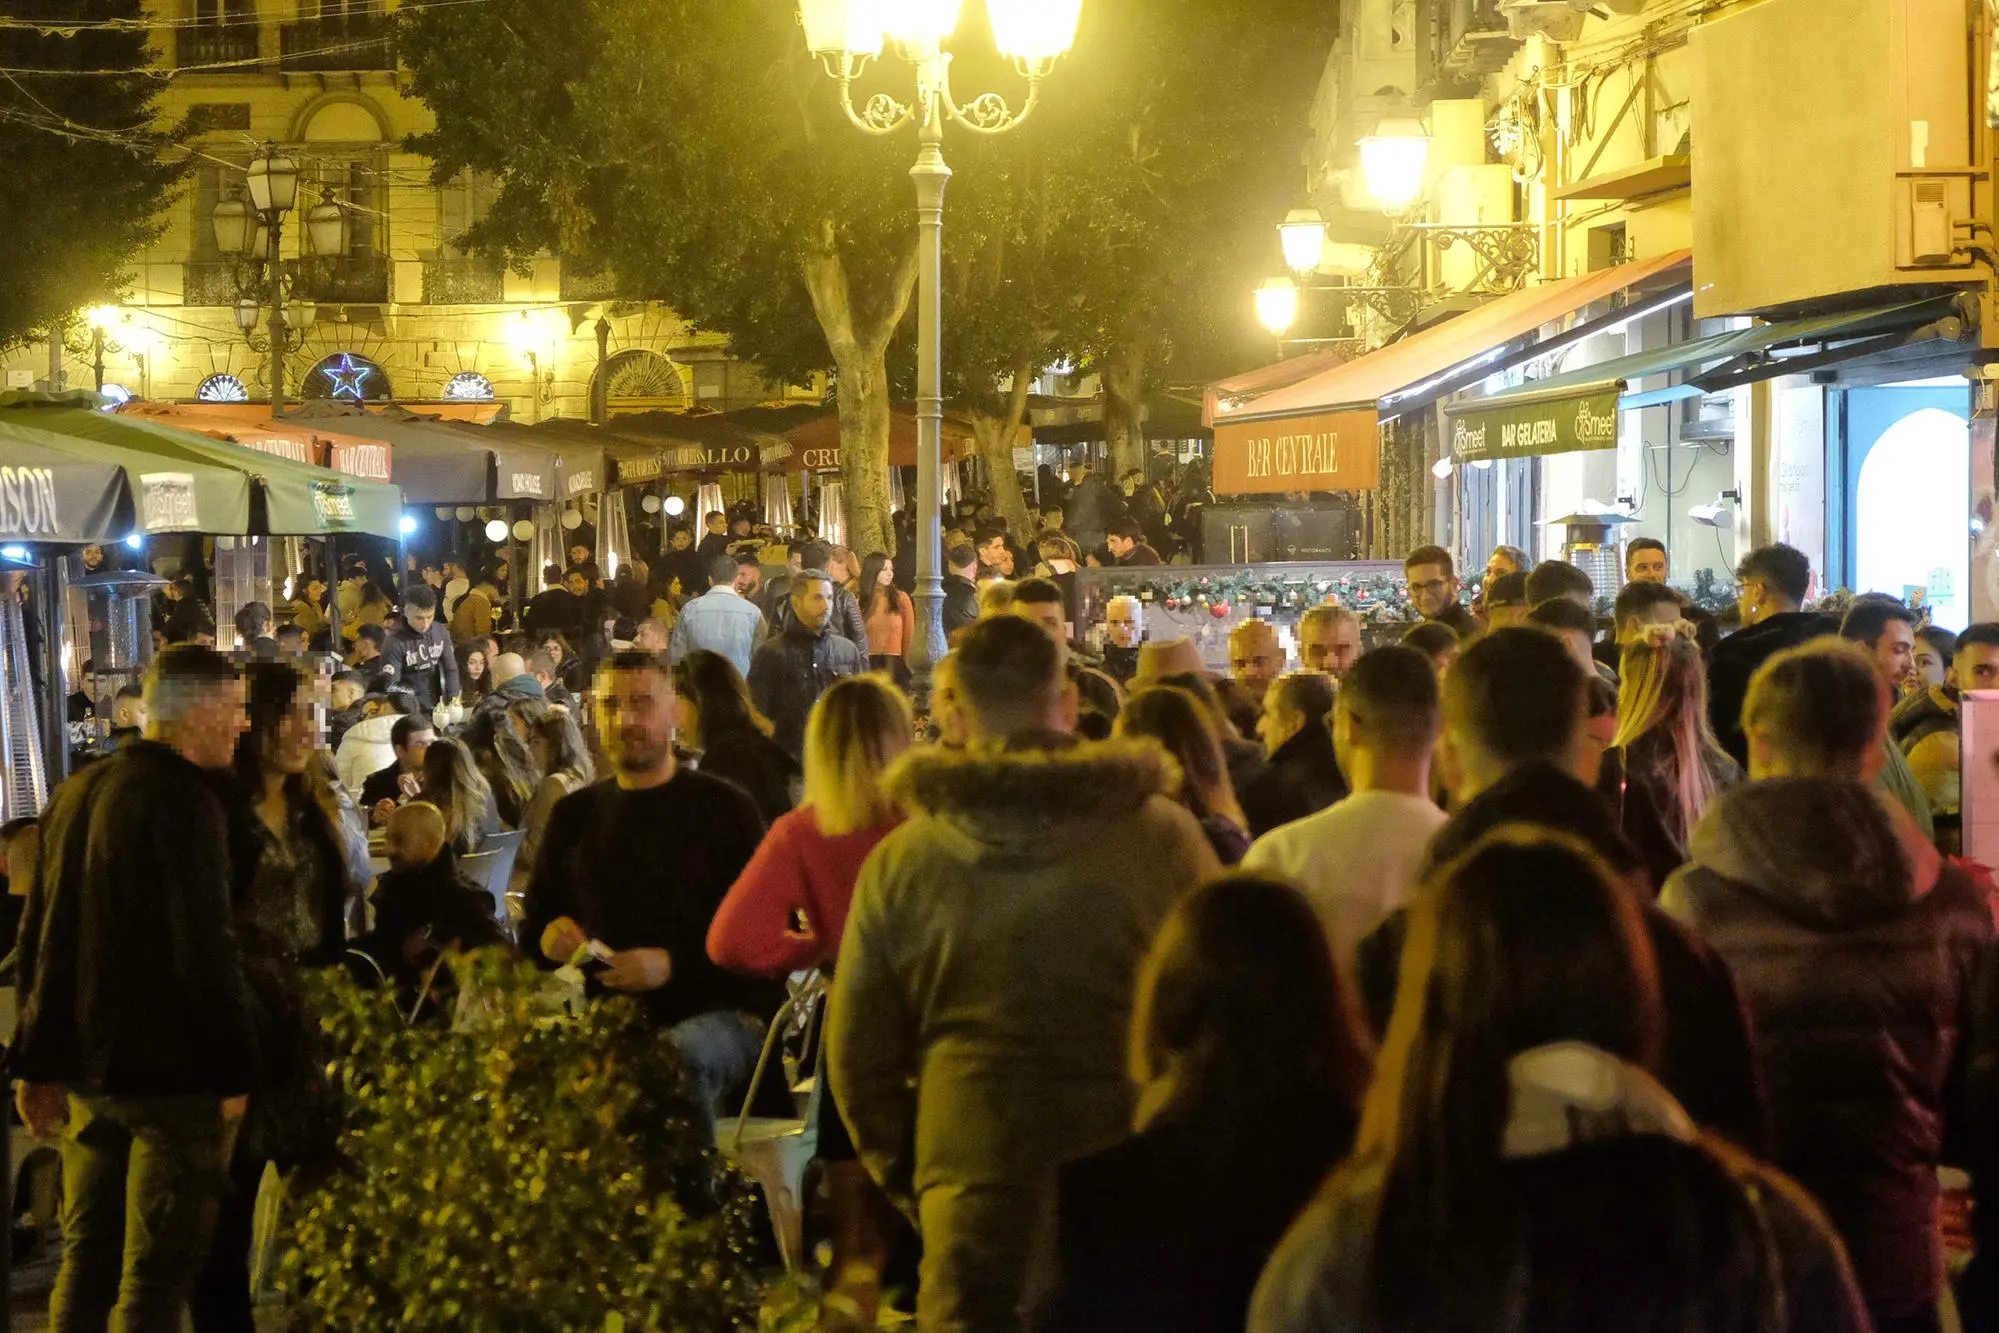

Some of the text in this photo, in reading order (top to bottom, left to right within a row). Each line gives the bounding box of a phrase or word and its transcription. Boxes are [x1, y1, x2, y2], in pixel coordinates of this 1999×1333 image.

[1502, 418, 1558, 447] BAR GELATERIA
[1247, 432, 1338, 477] BAR CENTRALE
